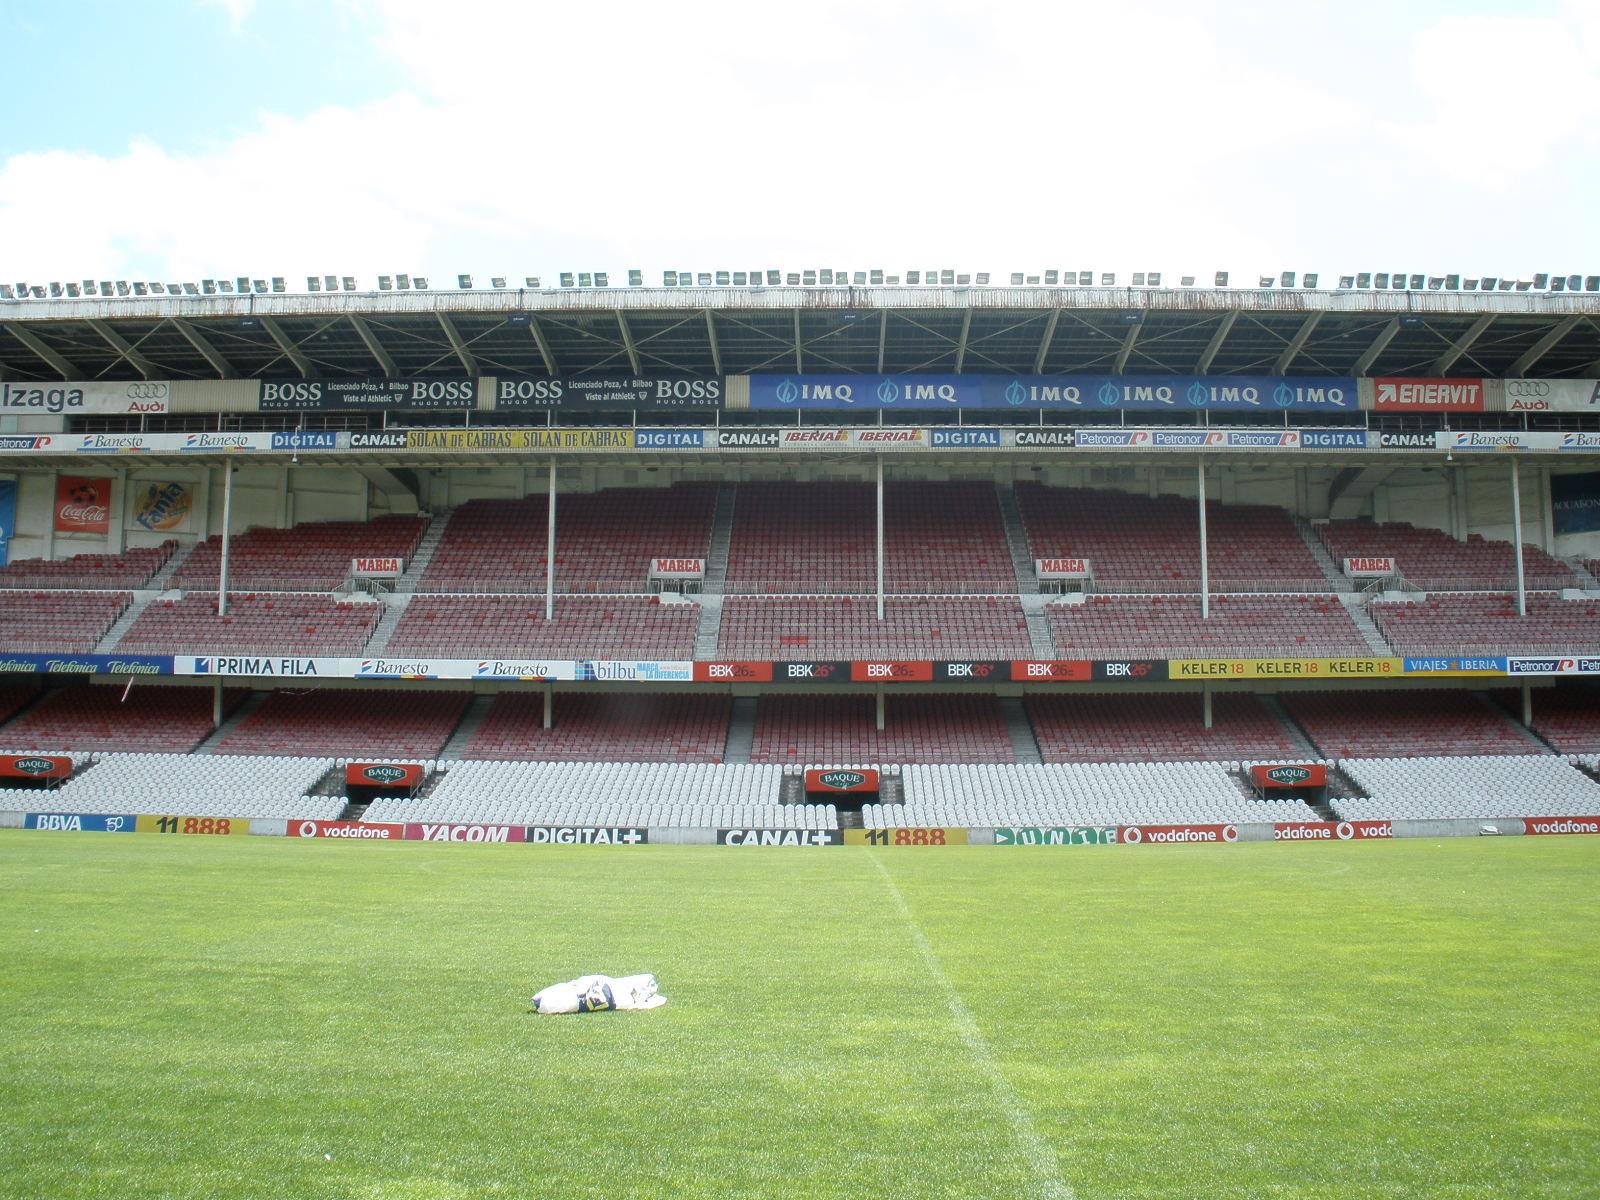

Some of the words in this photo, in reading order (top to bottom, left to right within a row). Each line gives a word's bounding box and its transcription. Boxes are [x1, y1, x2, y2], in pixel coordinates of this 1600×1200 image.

[264, 383, 322, 400] BOSS
[327, 382, 360, 391] Licenciado
[361, 382, 378, 392] Poza,
[379, 382, 384, 390] 4
[389, 382, 409, 391] Bilbao
[411, 382, 473, 400] BOSS
[500, 381, 563, 399] BOSS
[568, 381, 602, 389] Licenciado
[603, 381, 622, 390] Poza,
[632, 380, 653, 388] Bilbao
[656, 380, 720, 398] BOSS
[343, 394, 359, 402] Viste
[360, 394, 367, 402] al
[367, 394, 392, 402] Athletic
[585, 393, 602, 401] Viste
[610, 392, 636, 400] Athletic
[802, 384, 854, 403] IMQ
[904, 384, 957, 402] IMQ
[1030, 386, 1082, 404] IMQ
[1123, 386, 1175, 404] IMQ
[1210, 386, 1260, 405] IMQ
[1296, 387, 1346, 406] IMQ
[1400, 384, 1480, 404] ENERVIT
[127, 401, 165, 412] Audi
[1511, 399, 1549, 410] Audi
[95, 434, 143, 448] Banesto
[199, 433, 248, 447] Banesto
[351, 434, 407, 446] CANAL+
[451, 435, 464, 447] DE
[466, 431, 512, 447] CABRAS
[565, 434, 578, 446] DE
[581, 431, 627, 446] CABRAS
[719, 433, 778, 445] CANAL+
[784, 432, 835, 442] IBERIA
[858, 432, 909, 441] IBERIA
[1015, 432, 1075, 445] CANAL+
[1080, 433, 1125, 445] Petronor
[1156, 433, 1201, 445] Petronor
[1231, 433, 1276, 445] Petronor
[1380, 433, 1436, 446] CANAL+
[1470, 432, 1520, 446] Banesto
[136, 482, 185, 530] Fanta
[357, 559, 398, 571] MARCA
[657, 559, 701, 572] MARCA
[1041, 559, 1085, 572] MARCA
[1348, 559, 1391, 571] MARCA
[217, 658, 274, 674] PRIMA
[281, 659, 317, 675] FILA
[375, 660, 429, 675] Banesto
[493, 661, 548, 676] Banesto
[597, 662, 636, 679] bilbu
[1181, 663, 1227, 674] KELER
[1231, 663, 1244, 673] 18
[1256, 663, 1301, 673] KELER
[1305, 663, 1318, 673] 18
[1329, 662, 1374, 673] KELER
[1377, 662, 1391, 672] 18
[1411, 660, 1447, 672] VIAJES
[1461, 660, 1498, 670] IBERIA
[1513, 660, 1554, 672] Petronor
[18, 759, 49, 770] BAQUE
[368, 764, 402, 777] BAQUE
[824, 773, 860, 784] BAQUE
[1272, 767, 1306, 778] BAQUE
[36, 815, 82, 831] BBVA
[1532, 820, 1598, 833] vodafone
[323, 826, 389, 839] vodafone
[421, 825, 509, 842] YACOM
[533, 828, 642, 844] DIGITAL+
[725, 830, 832, 846] CANAL+
[1148, 828, 1217, 843] vodafone
